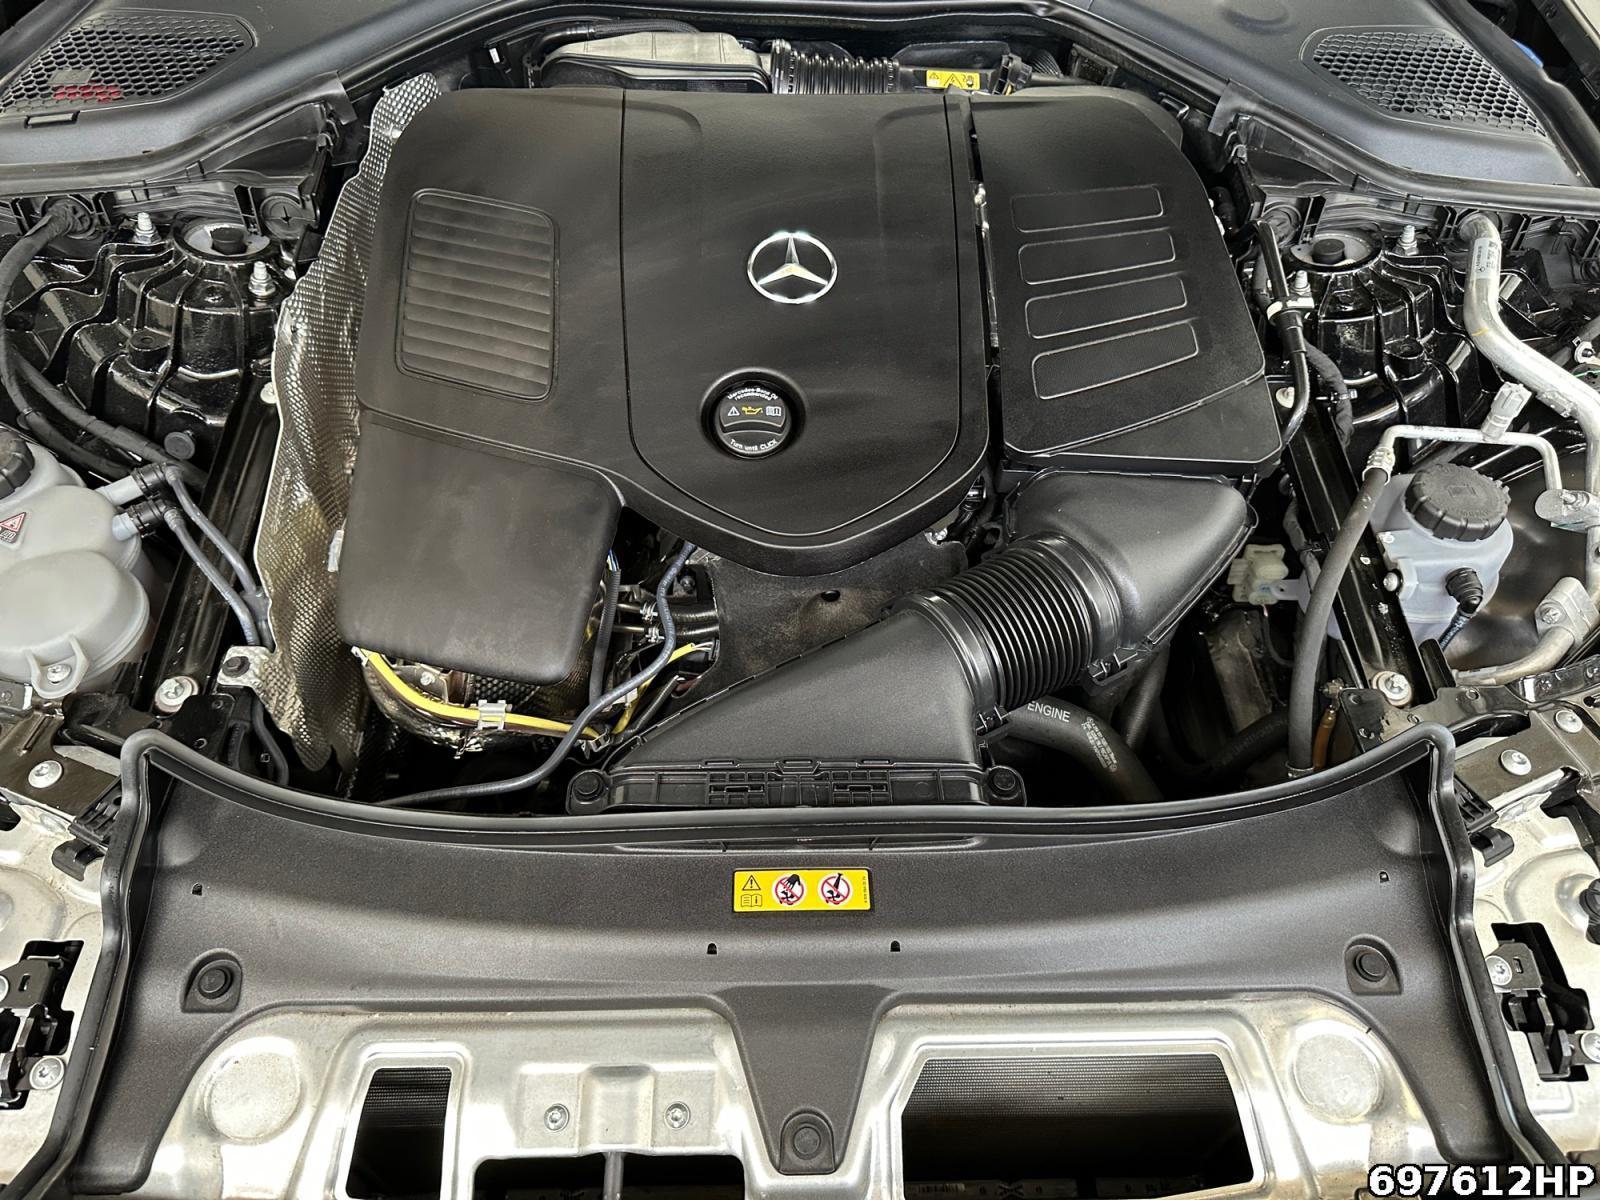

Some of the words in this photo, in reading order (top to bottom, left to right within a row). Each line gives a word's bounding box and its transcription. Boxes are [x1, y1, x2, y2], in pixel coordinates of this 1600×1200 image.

[730, 438, 743, 449] Turn
[760, 438, 778, 450] CLICK
[1027, 700, 1071, 723] ENGINE
